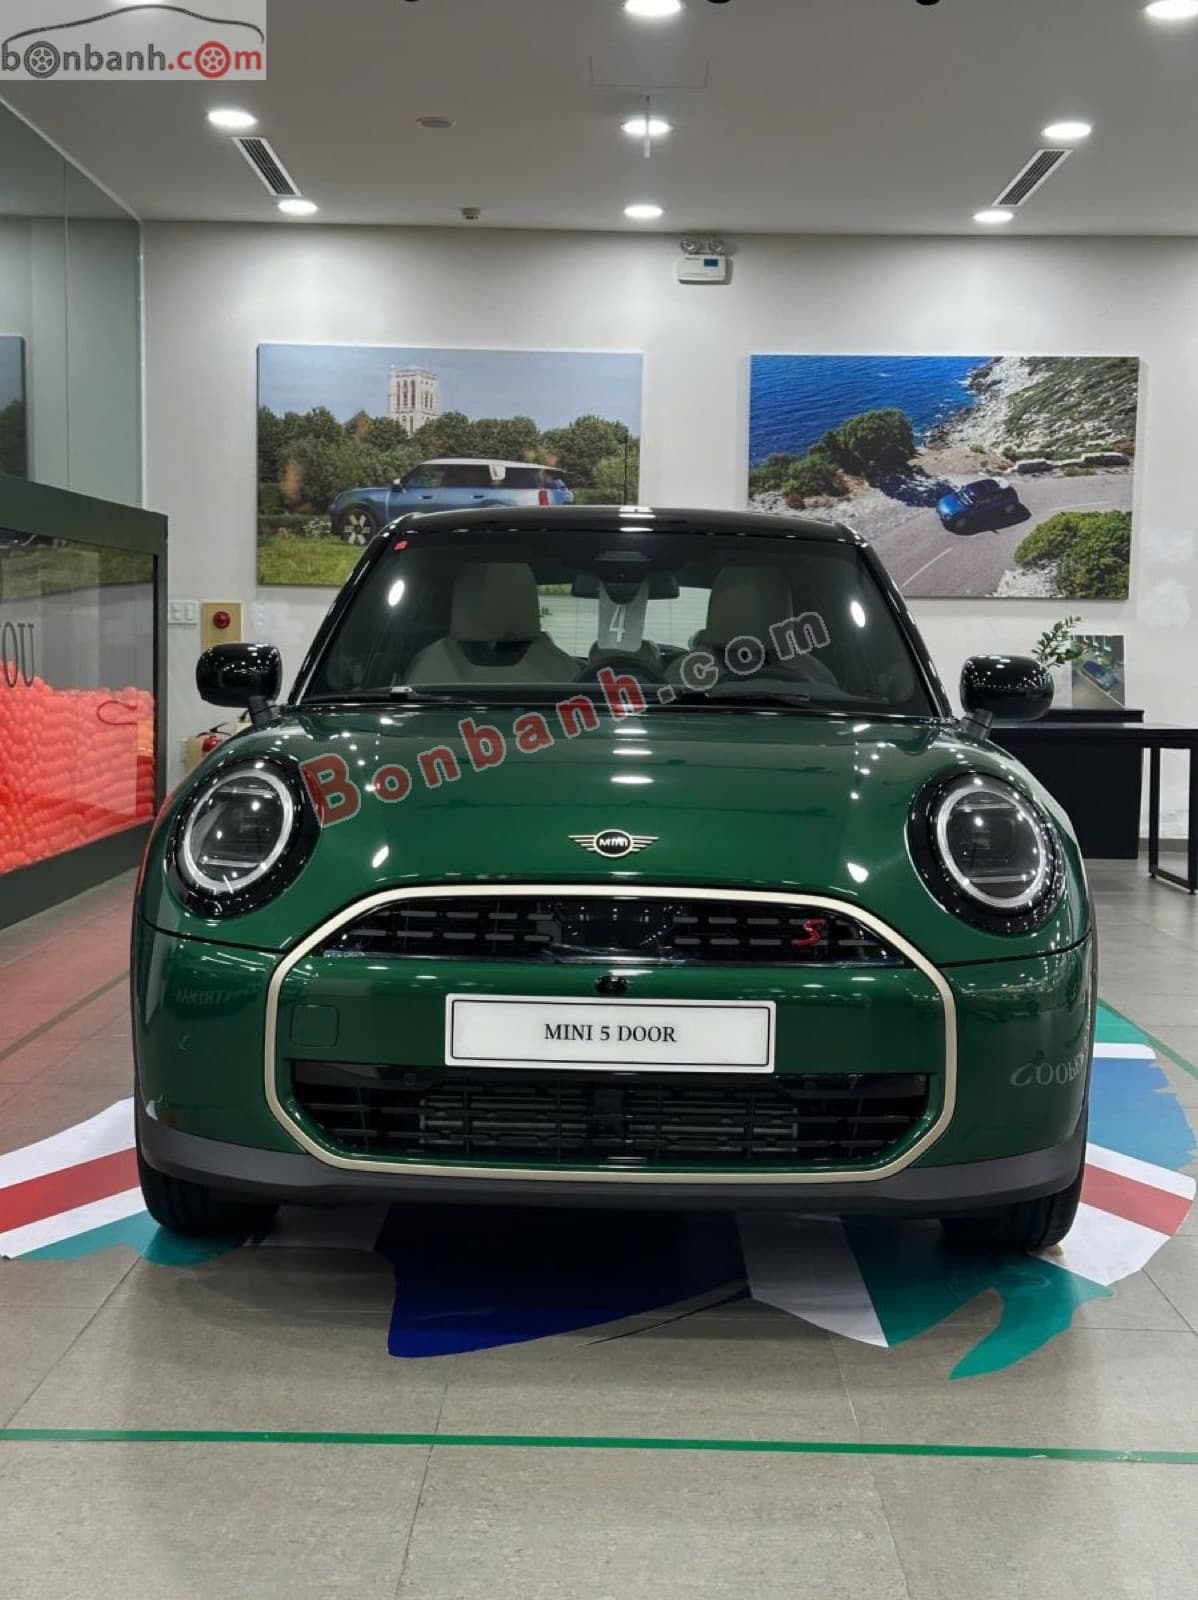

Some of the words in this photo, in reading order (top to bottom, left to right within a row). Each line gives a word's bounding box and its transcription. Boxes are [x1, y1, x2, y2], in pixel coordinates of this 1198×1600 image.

[609, 604, 626, 643] 4
[0, 621, 34, 688] OU
[791, 918, 825, 946] S
[544, 1023, 593, 1041] MINI
[600, 1025, 610, 1041] 5
[617, 1025, 677, 1042] DOOR
